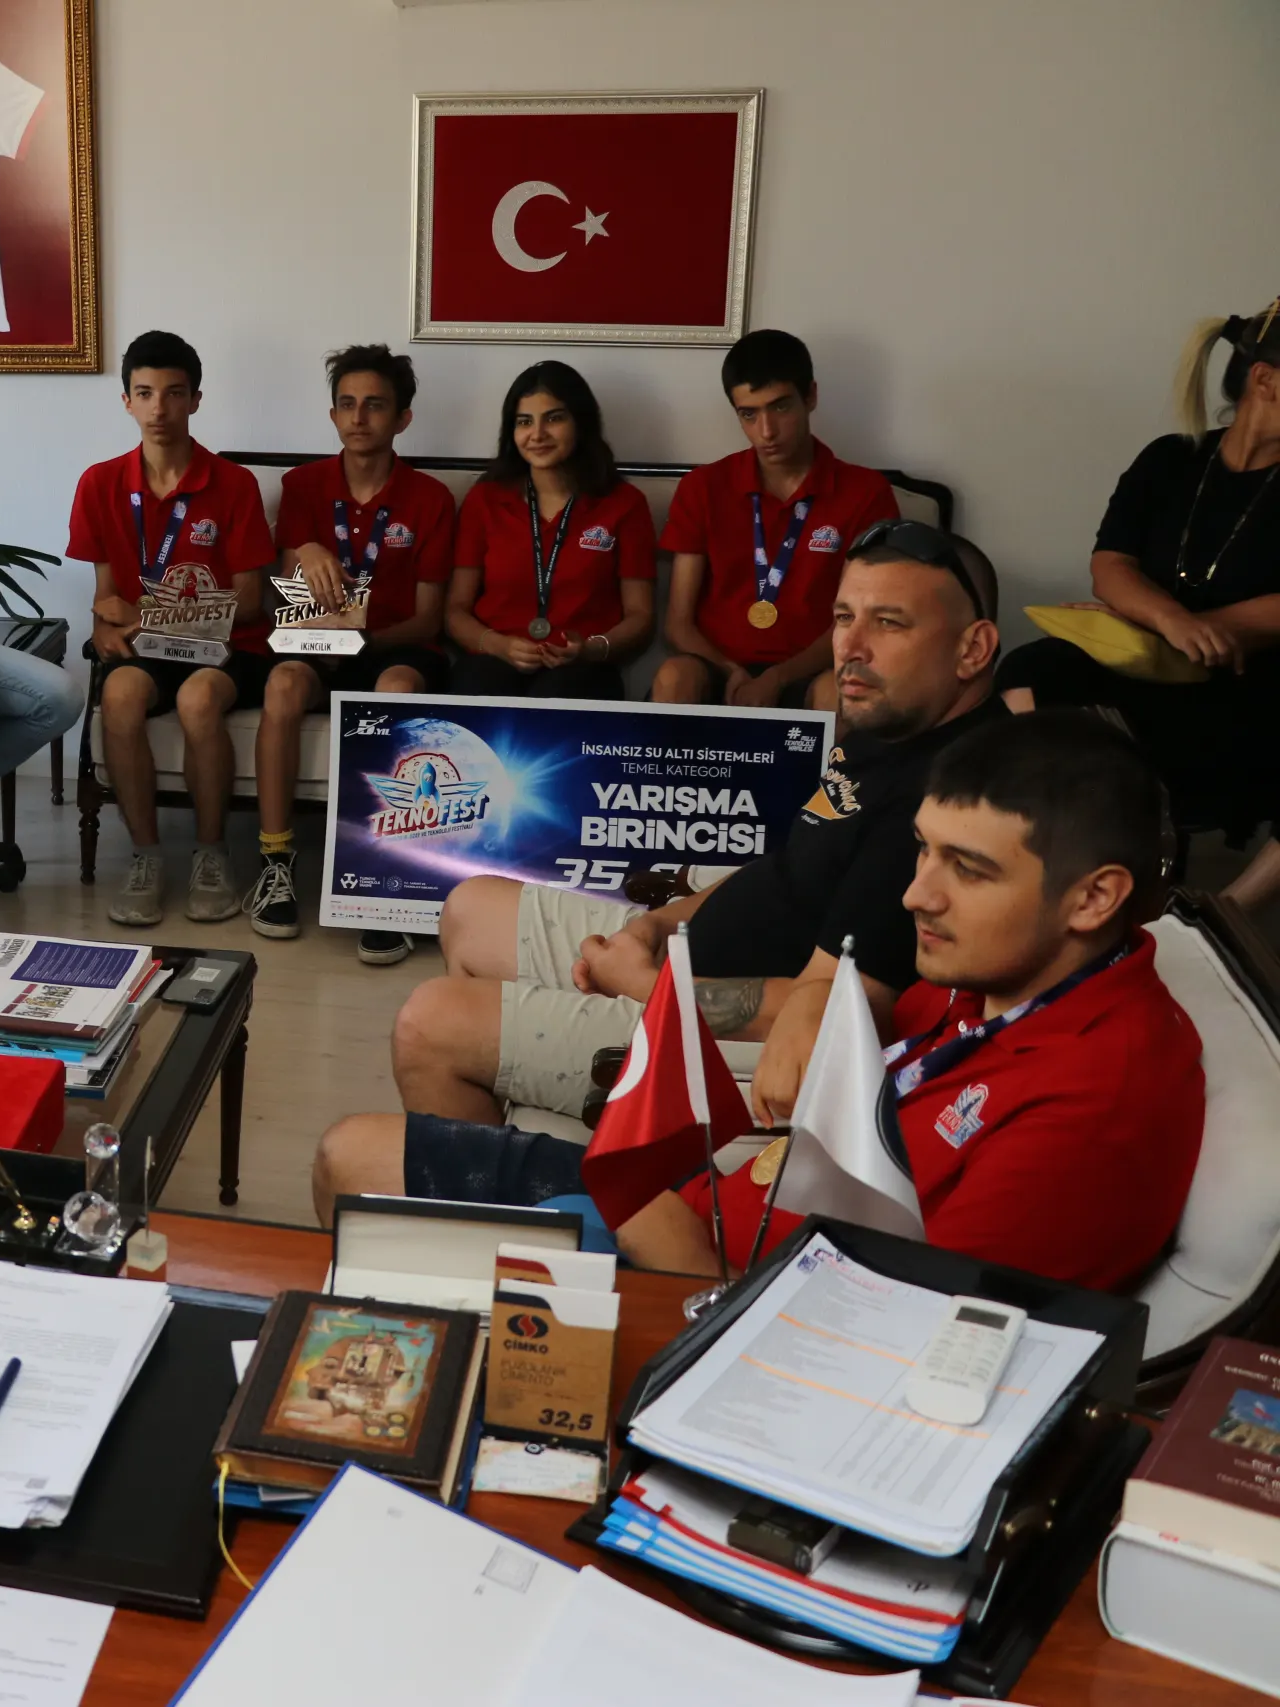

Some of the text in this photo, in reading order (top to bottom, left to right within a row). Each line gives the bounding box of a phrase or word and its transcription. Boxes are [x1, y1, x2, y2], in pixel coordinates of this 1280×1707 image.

[141, 602, 236, 628] TEKNOFEST
[276, 589, 368, 626] TEKNT
[581, 741, 775, 764] İNSANSIZ SU ALTI SİSTEMLERİ
[621, 762, 732, 778] TEMEL KATEGORİ
[591, 782, 759, 817] YARIŞMA
[370, 793, 490, 837] TEKNOFEST
[503, 1339, 549, 1355] ÇİMKO
[538, 1408, 593, 1432] 32,5
